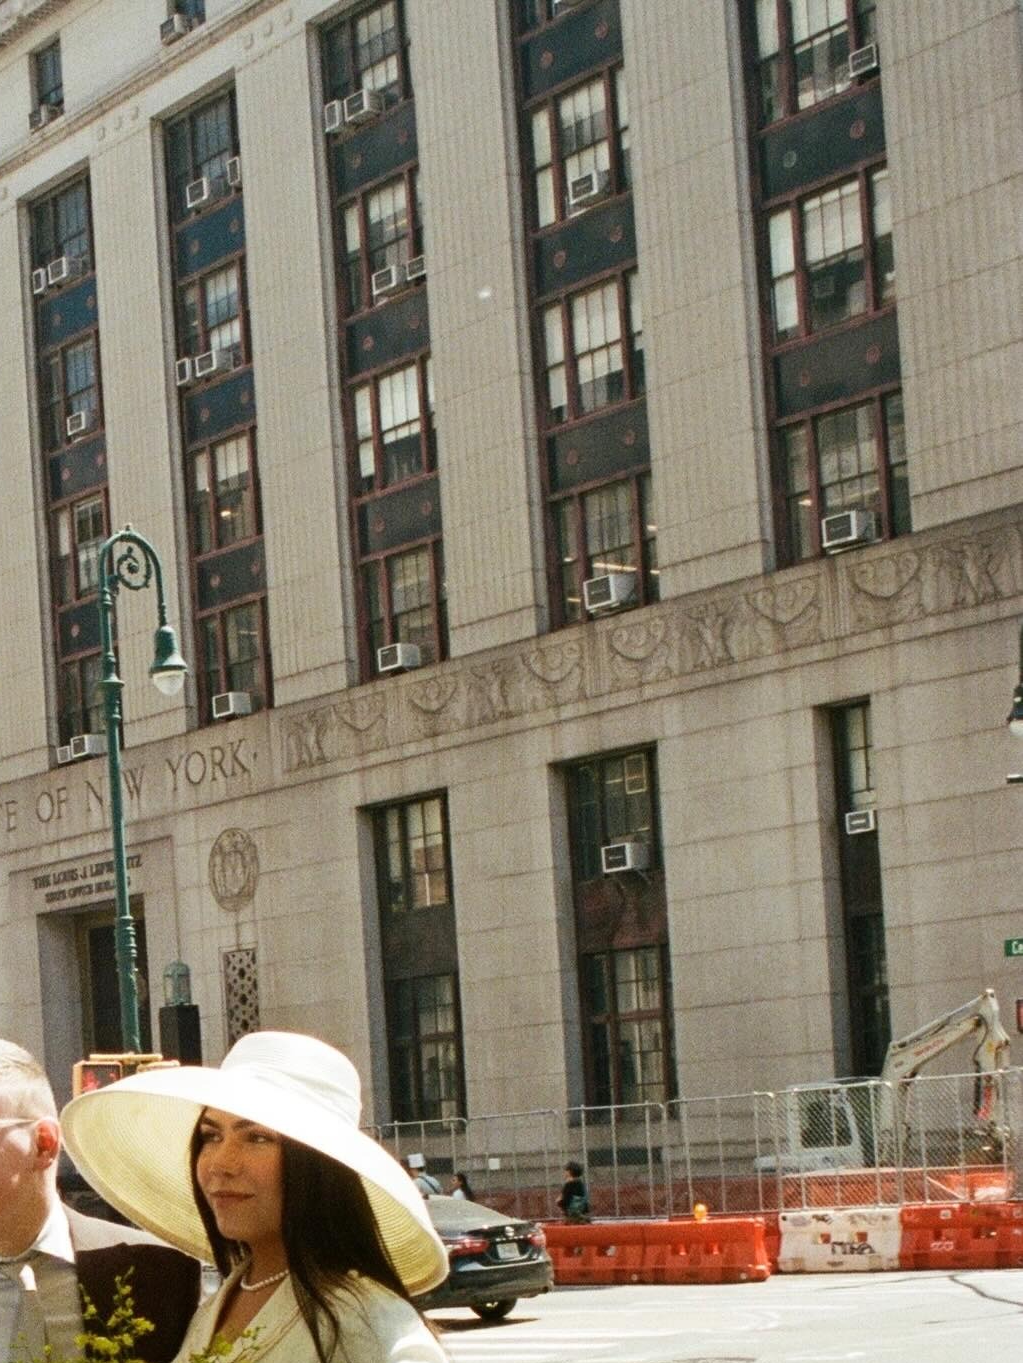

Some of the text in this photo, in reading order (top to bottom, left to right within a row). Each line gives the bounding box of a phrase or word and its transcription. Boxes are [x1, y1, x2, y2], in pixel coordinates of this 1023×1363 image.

[35, 786, 67, 823] OF
[84, 766, 145, 813] NW
[165, 737, 251, 792] YORK
